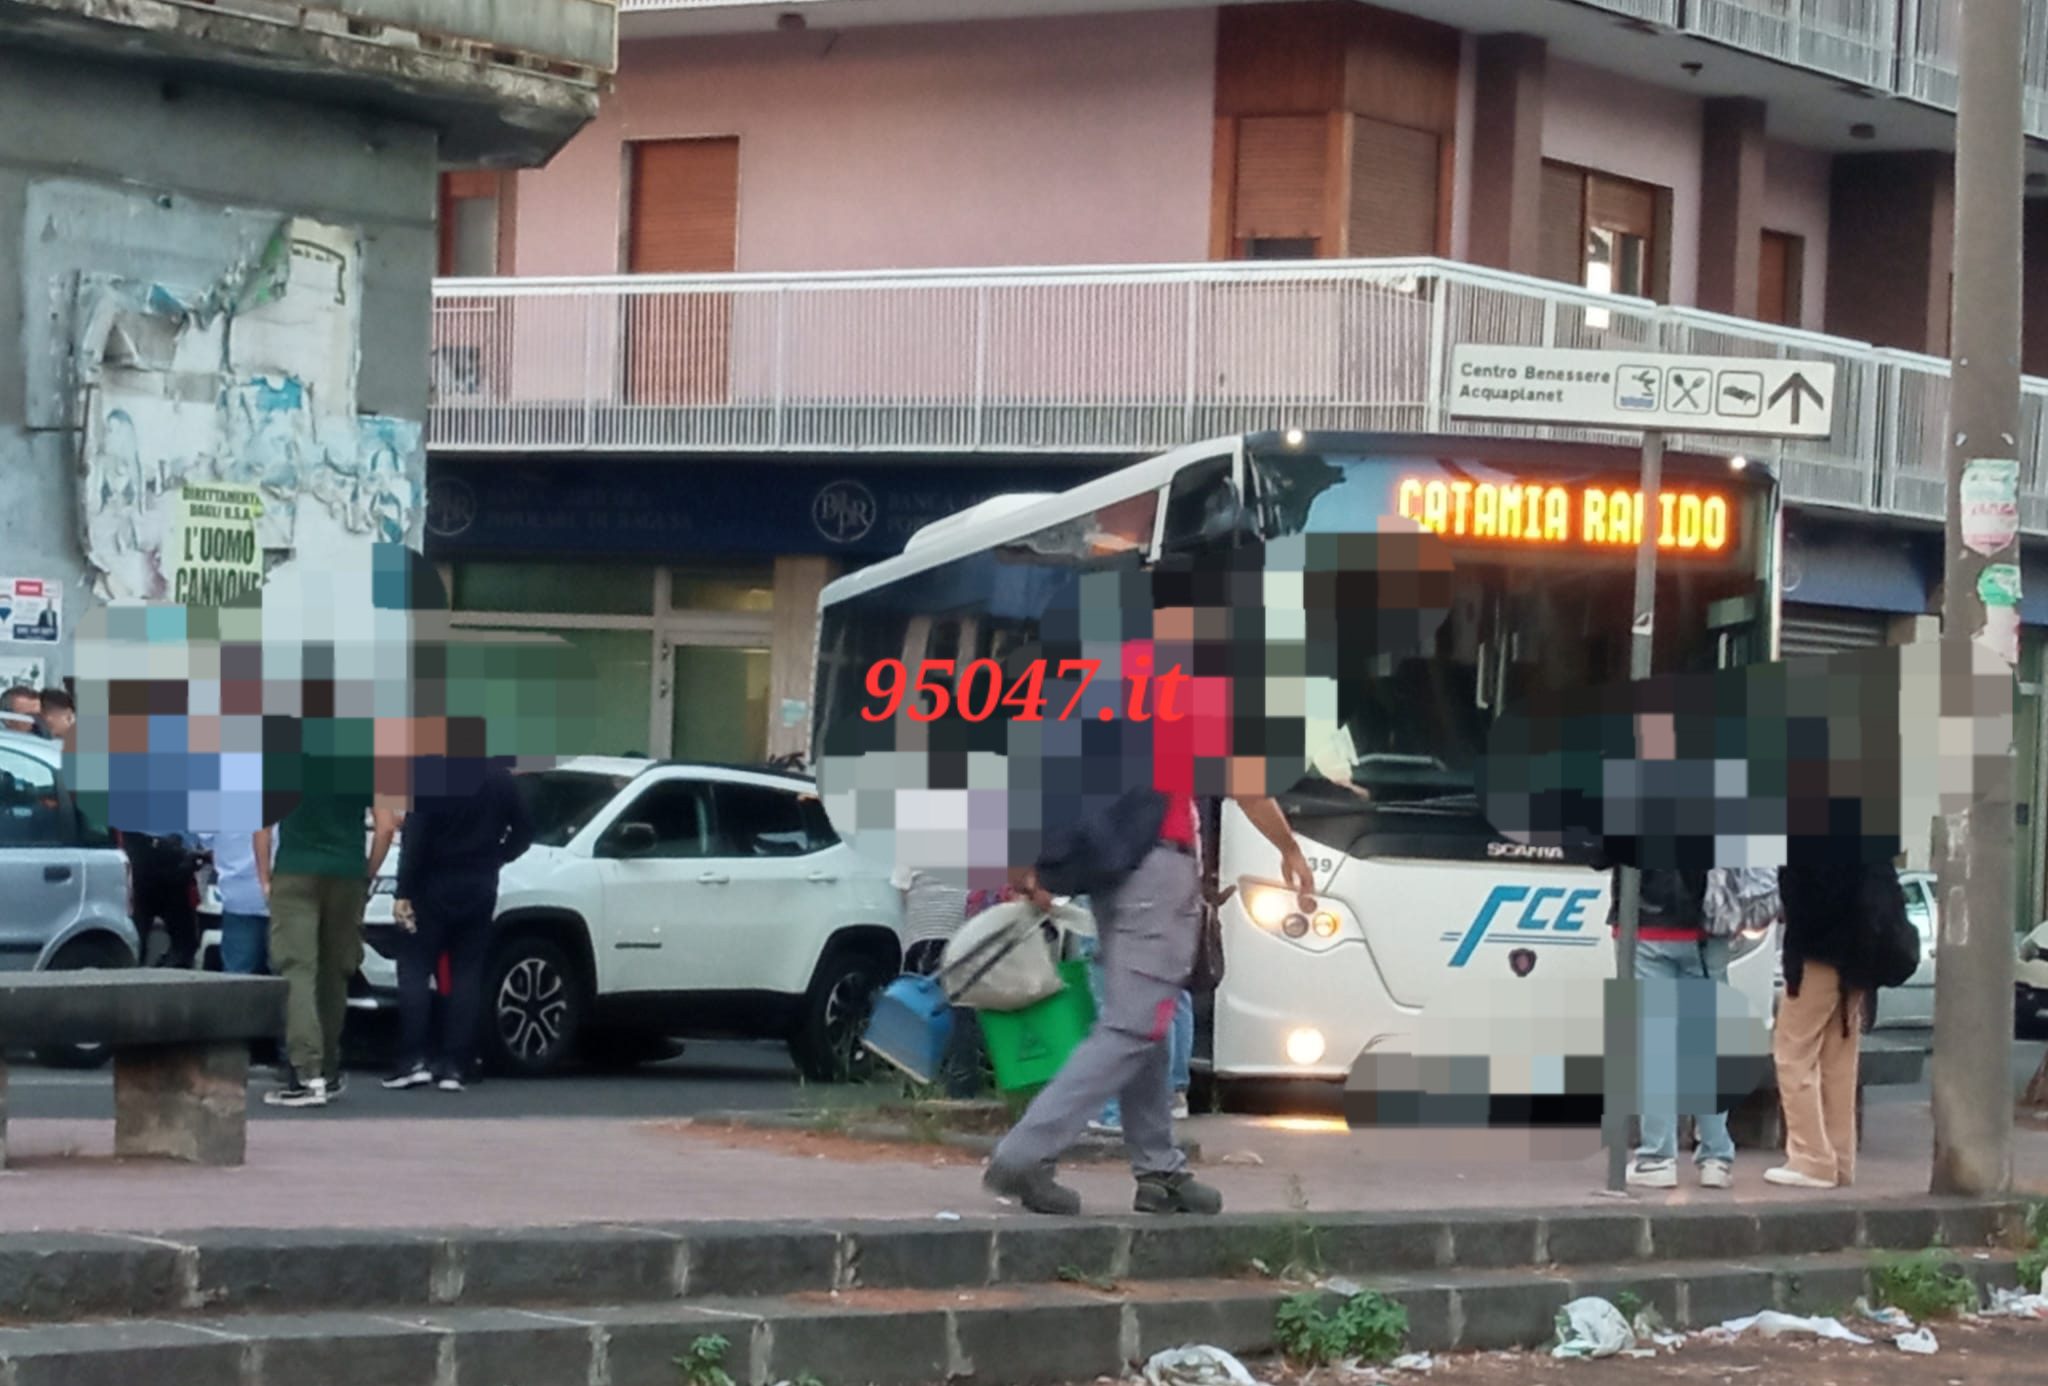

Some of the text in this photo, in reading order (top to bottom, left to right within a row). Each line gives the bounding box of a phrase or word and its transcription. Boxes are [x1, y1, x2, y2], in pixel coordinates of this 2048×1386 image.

[1460, 362, 1611, 384] Centro Benessere
[1458, 384, 1564, 403] Acquaplanet
[184, 526, 255, 566] L'UOMO
